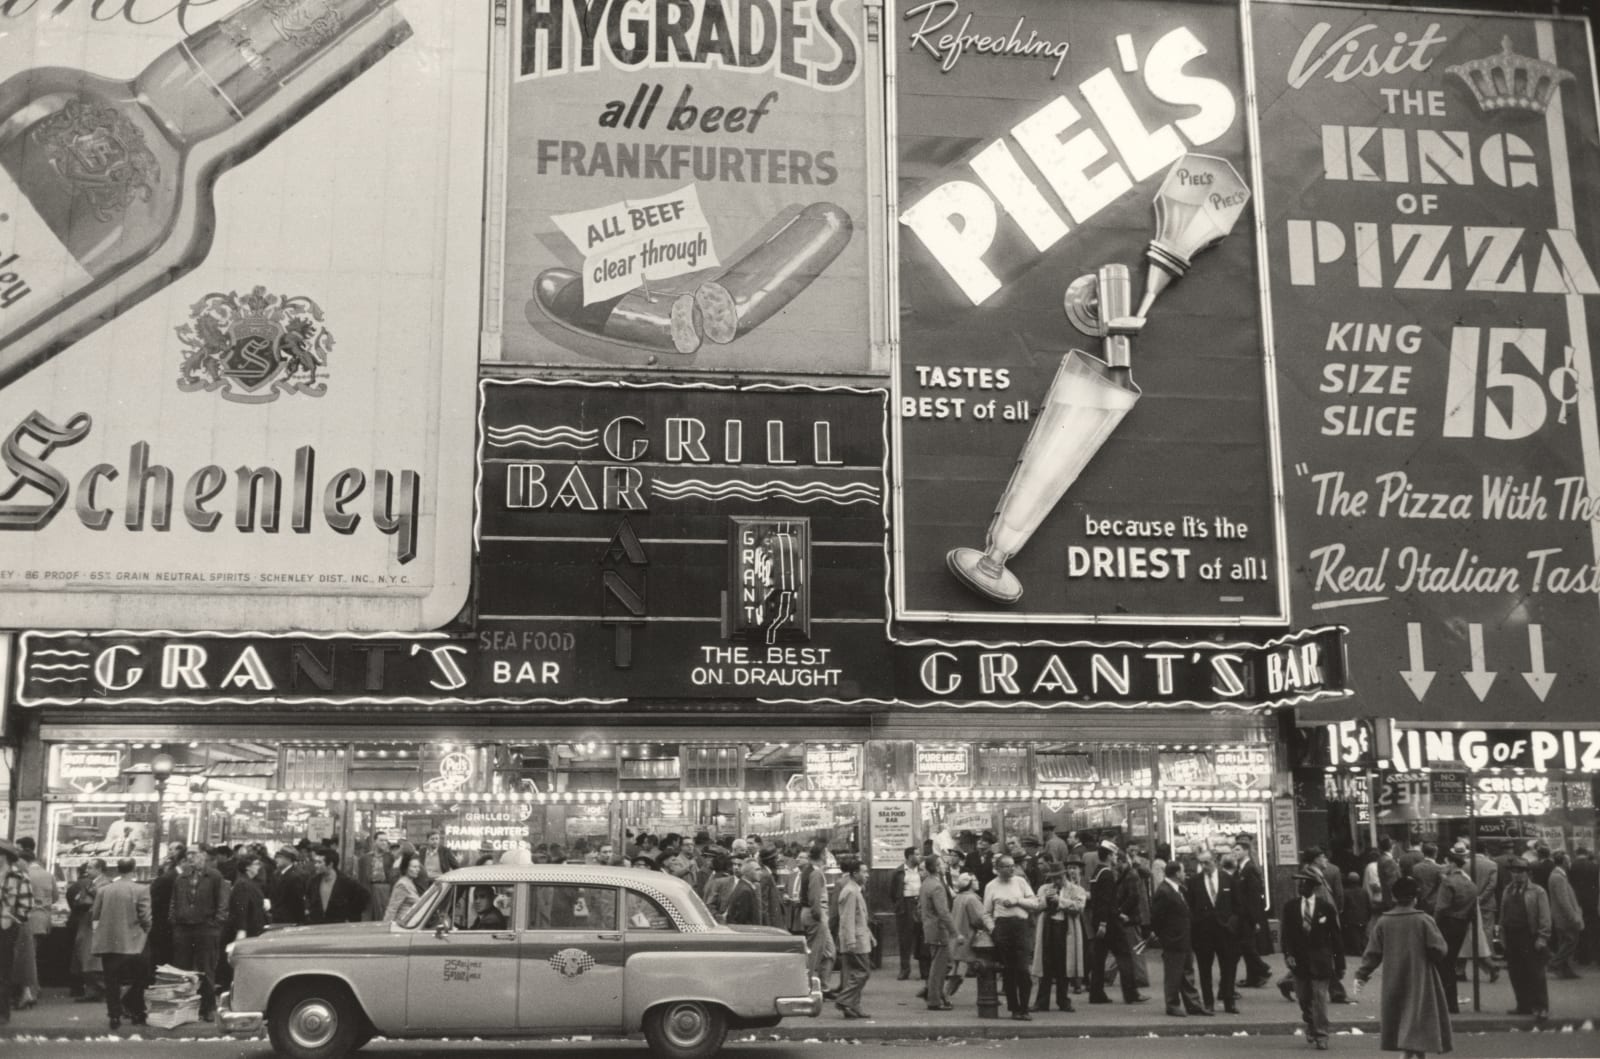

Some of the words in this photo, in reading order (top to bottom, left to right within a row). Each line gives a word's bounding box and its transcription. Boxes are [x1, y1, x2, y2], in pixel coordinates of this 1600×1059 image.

[516, 0, 860, 89] HYGRADES
[904, 0, 1070, 79] Refreshing
[1287, 22, 1447, 90] Visit
[598, 83, 663, 130] all
[666, 84, 779, 134] beef
[1380, 88, 1447, 116] THE
[536, 138, 839, 186] FRANKFURTERS
[898, 26, 1236, 306] PIEL'S
[1321, 124, 1539, 188] KING
[587, 222, 625, 249] ALL
[628, 199, 686, 231] BEEF
[1396, 193, 1439, 215] OF
[593, 253, 636, 284] clear
[640, 232, 708, 268] through
[1287, 219, 1600, 295] PIZZA
[1325, 322, 1423, 354] KING
[915, 365, 1011, 390] TASTES
[1319, 363, 1413, 394] SIZE
[1442, 326, 1579, 440] 15¢
[901, 397, 966, 420] BEST
[973, 398, 997, 420] of
[1003, 399, 1030, 422] all
[1321, 405, 1417, 436] SLICE
[602, 415, 844, 465] GRILL
[0, 409, 420, 566] Schenley
[506, 464, 649, 511] BAR
[1375, 471, 1474, 519] Pizza
[1482, 474, 1548, 521] With
[1085, 514, 1176, 537] because
[1215, 515, 1249, 539] the
[44, 571, 79, 580] PROOF
[116, 572, 150, 581] GRAIN
[155, 572, 205, 582] NEUTRAL
[209, 573, 250, 582] SPIRITS
[260, 573, 315, 583] SCHENLEY
[1067, 546, 1192, 579] DRIEST
[1199, 556, 1223, 581] of
[1309, 543, 1391, 593] Real
[1394, 546, 1520, 593] Italian
[479, 630, 518, 651] SEA
[522, 631, 577, 652] FOOD
[701, 645, 749, 664] THE
[766, 647, 831, 665] BEST
[94, 643, 468, 691] GRANT'S
[492, 660, 561, 684] BAR
[691, 668, 726, 685] ON
[733, 669, 843, 686] DRAUGHT
[920, 652, 1246, 696] GRANT'S
[1266, 642, 1322, 694] BAR
[1327, 719, 1368, 765] 15¢
[1492, 740, 1527, 762] OF
[1478, 777, 1549, 792] CRISPY
[445, 825, 530, 836] FRANKFURTERS
[446, 839, 528, 851] HAMBGERS
